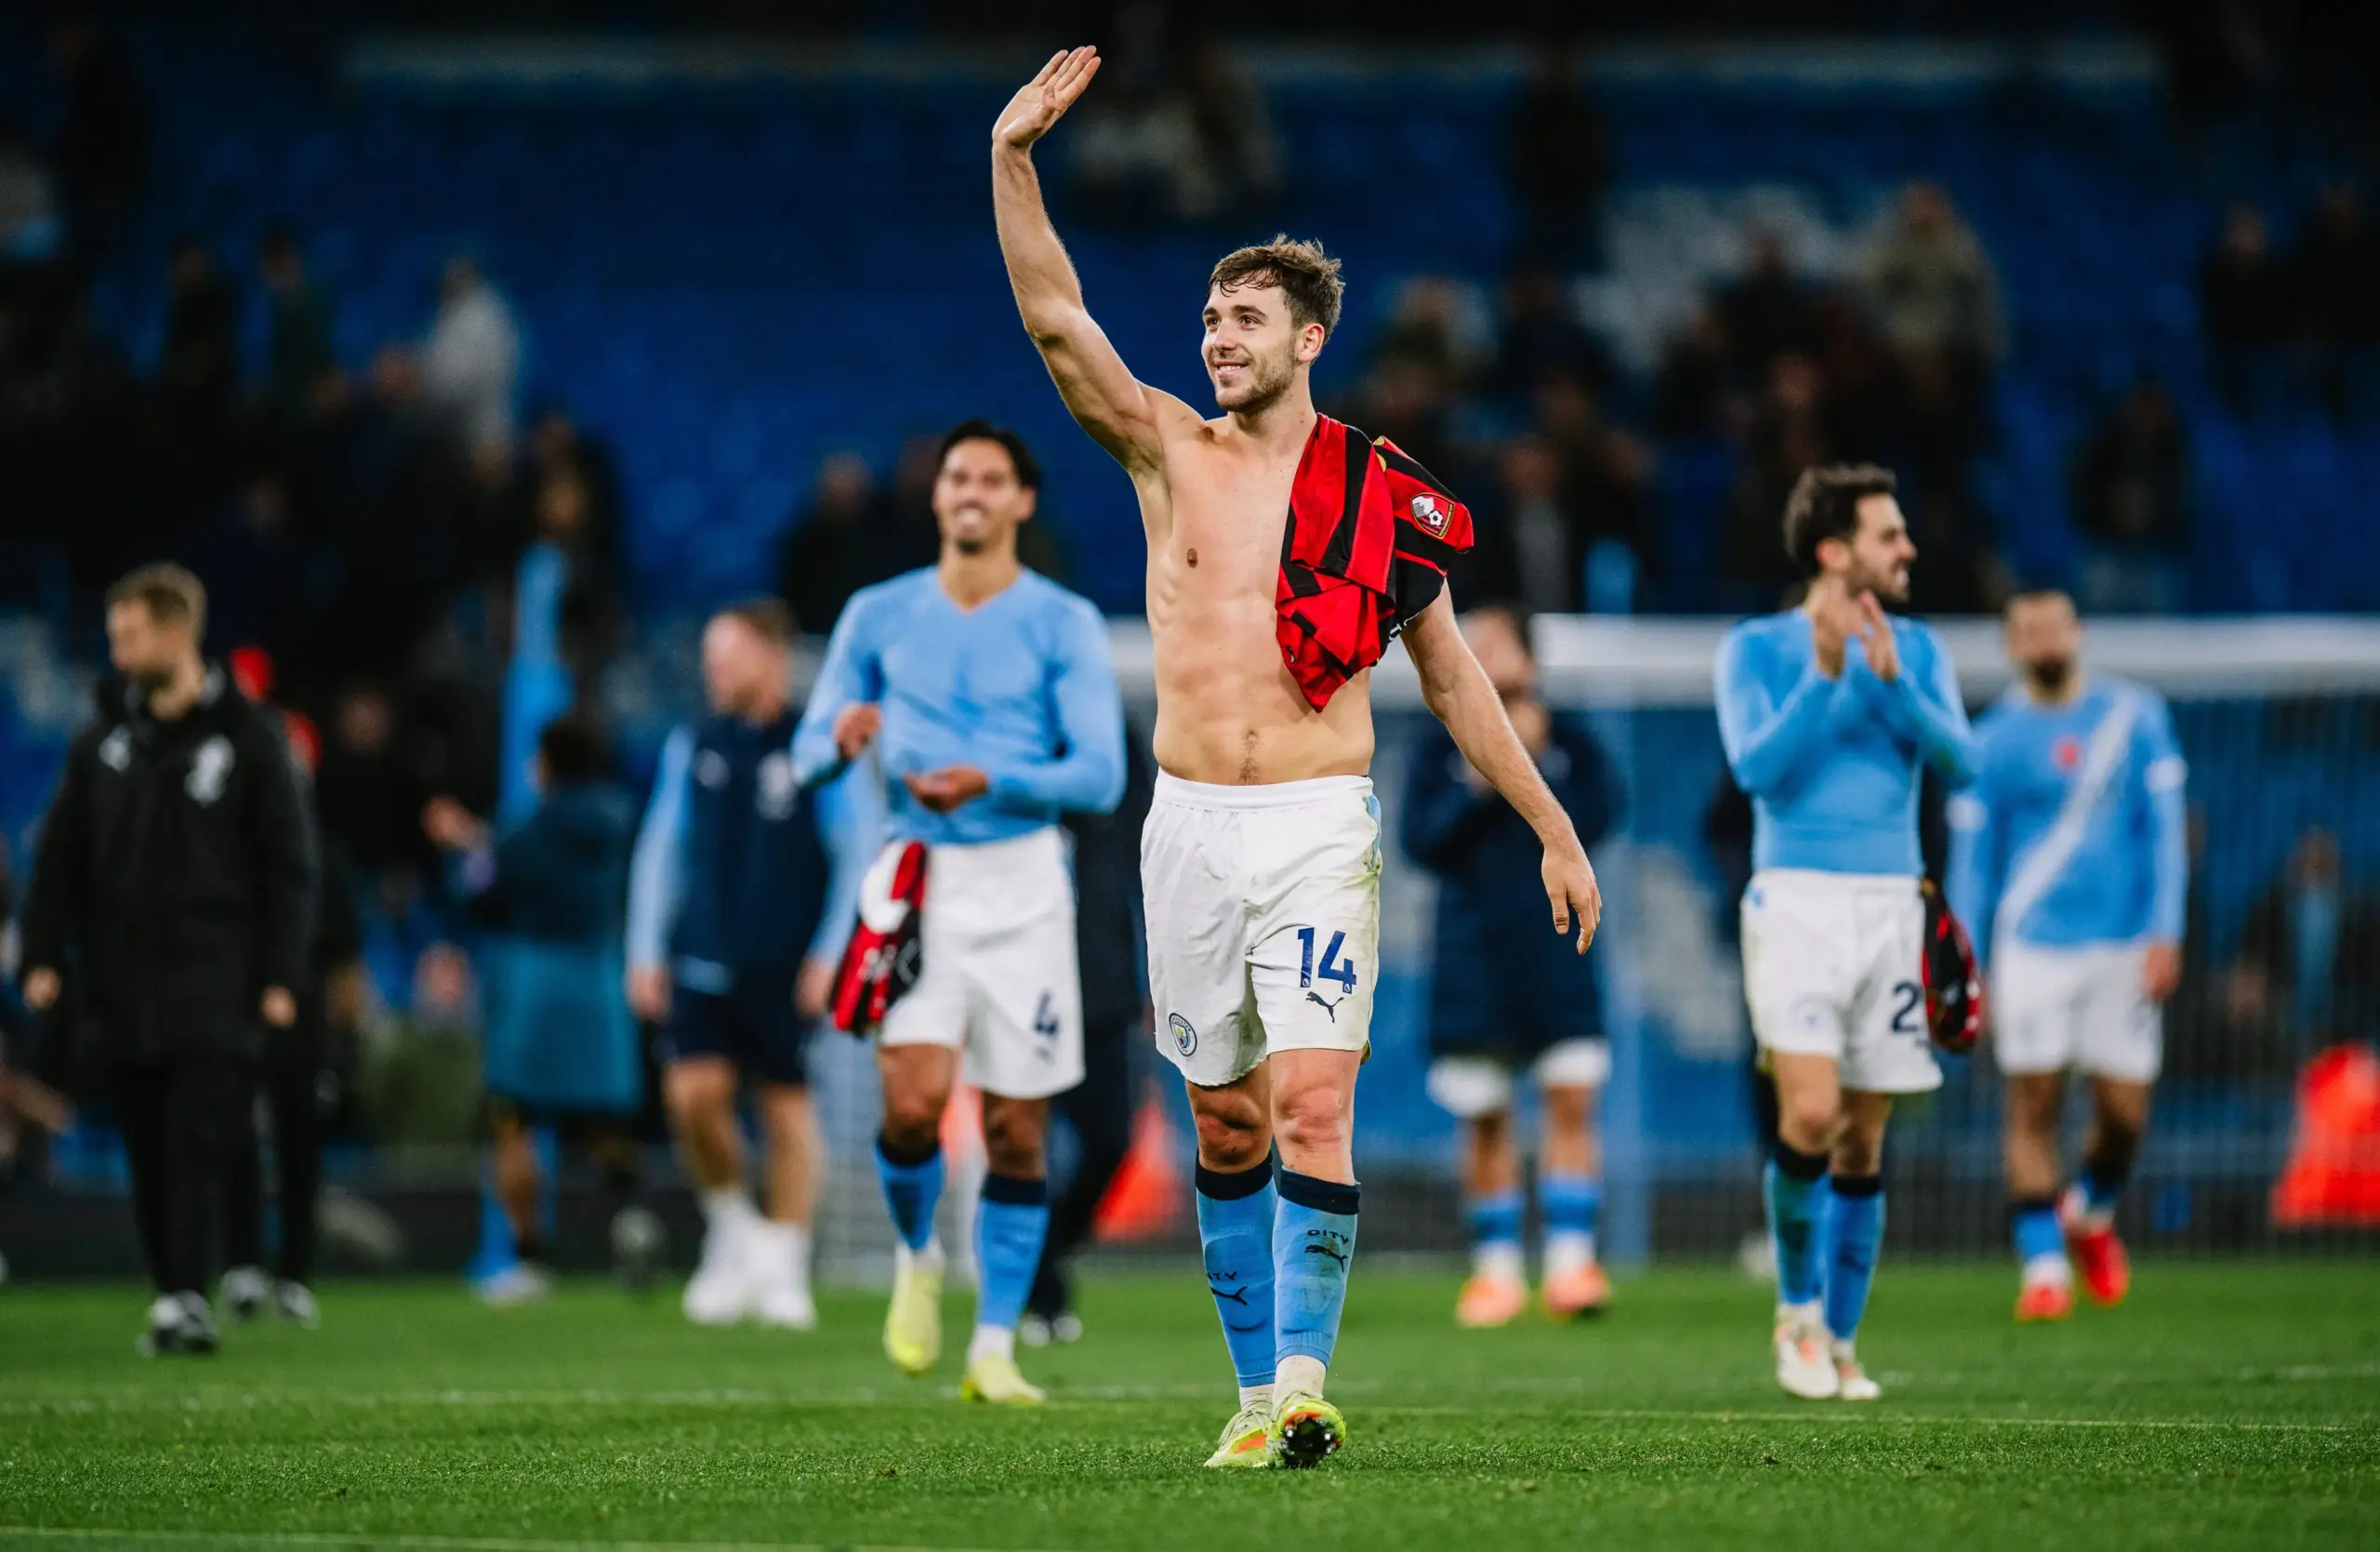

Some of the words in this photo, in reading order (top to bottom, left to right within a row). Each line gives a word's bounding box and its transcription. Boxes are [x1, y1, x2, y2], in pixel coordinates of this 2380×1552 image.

[1298, 927, 1356, 994] 14
[1034, 989, 1060, 1041] 4
[1206, 1271, 1237, 1280] ITY
